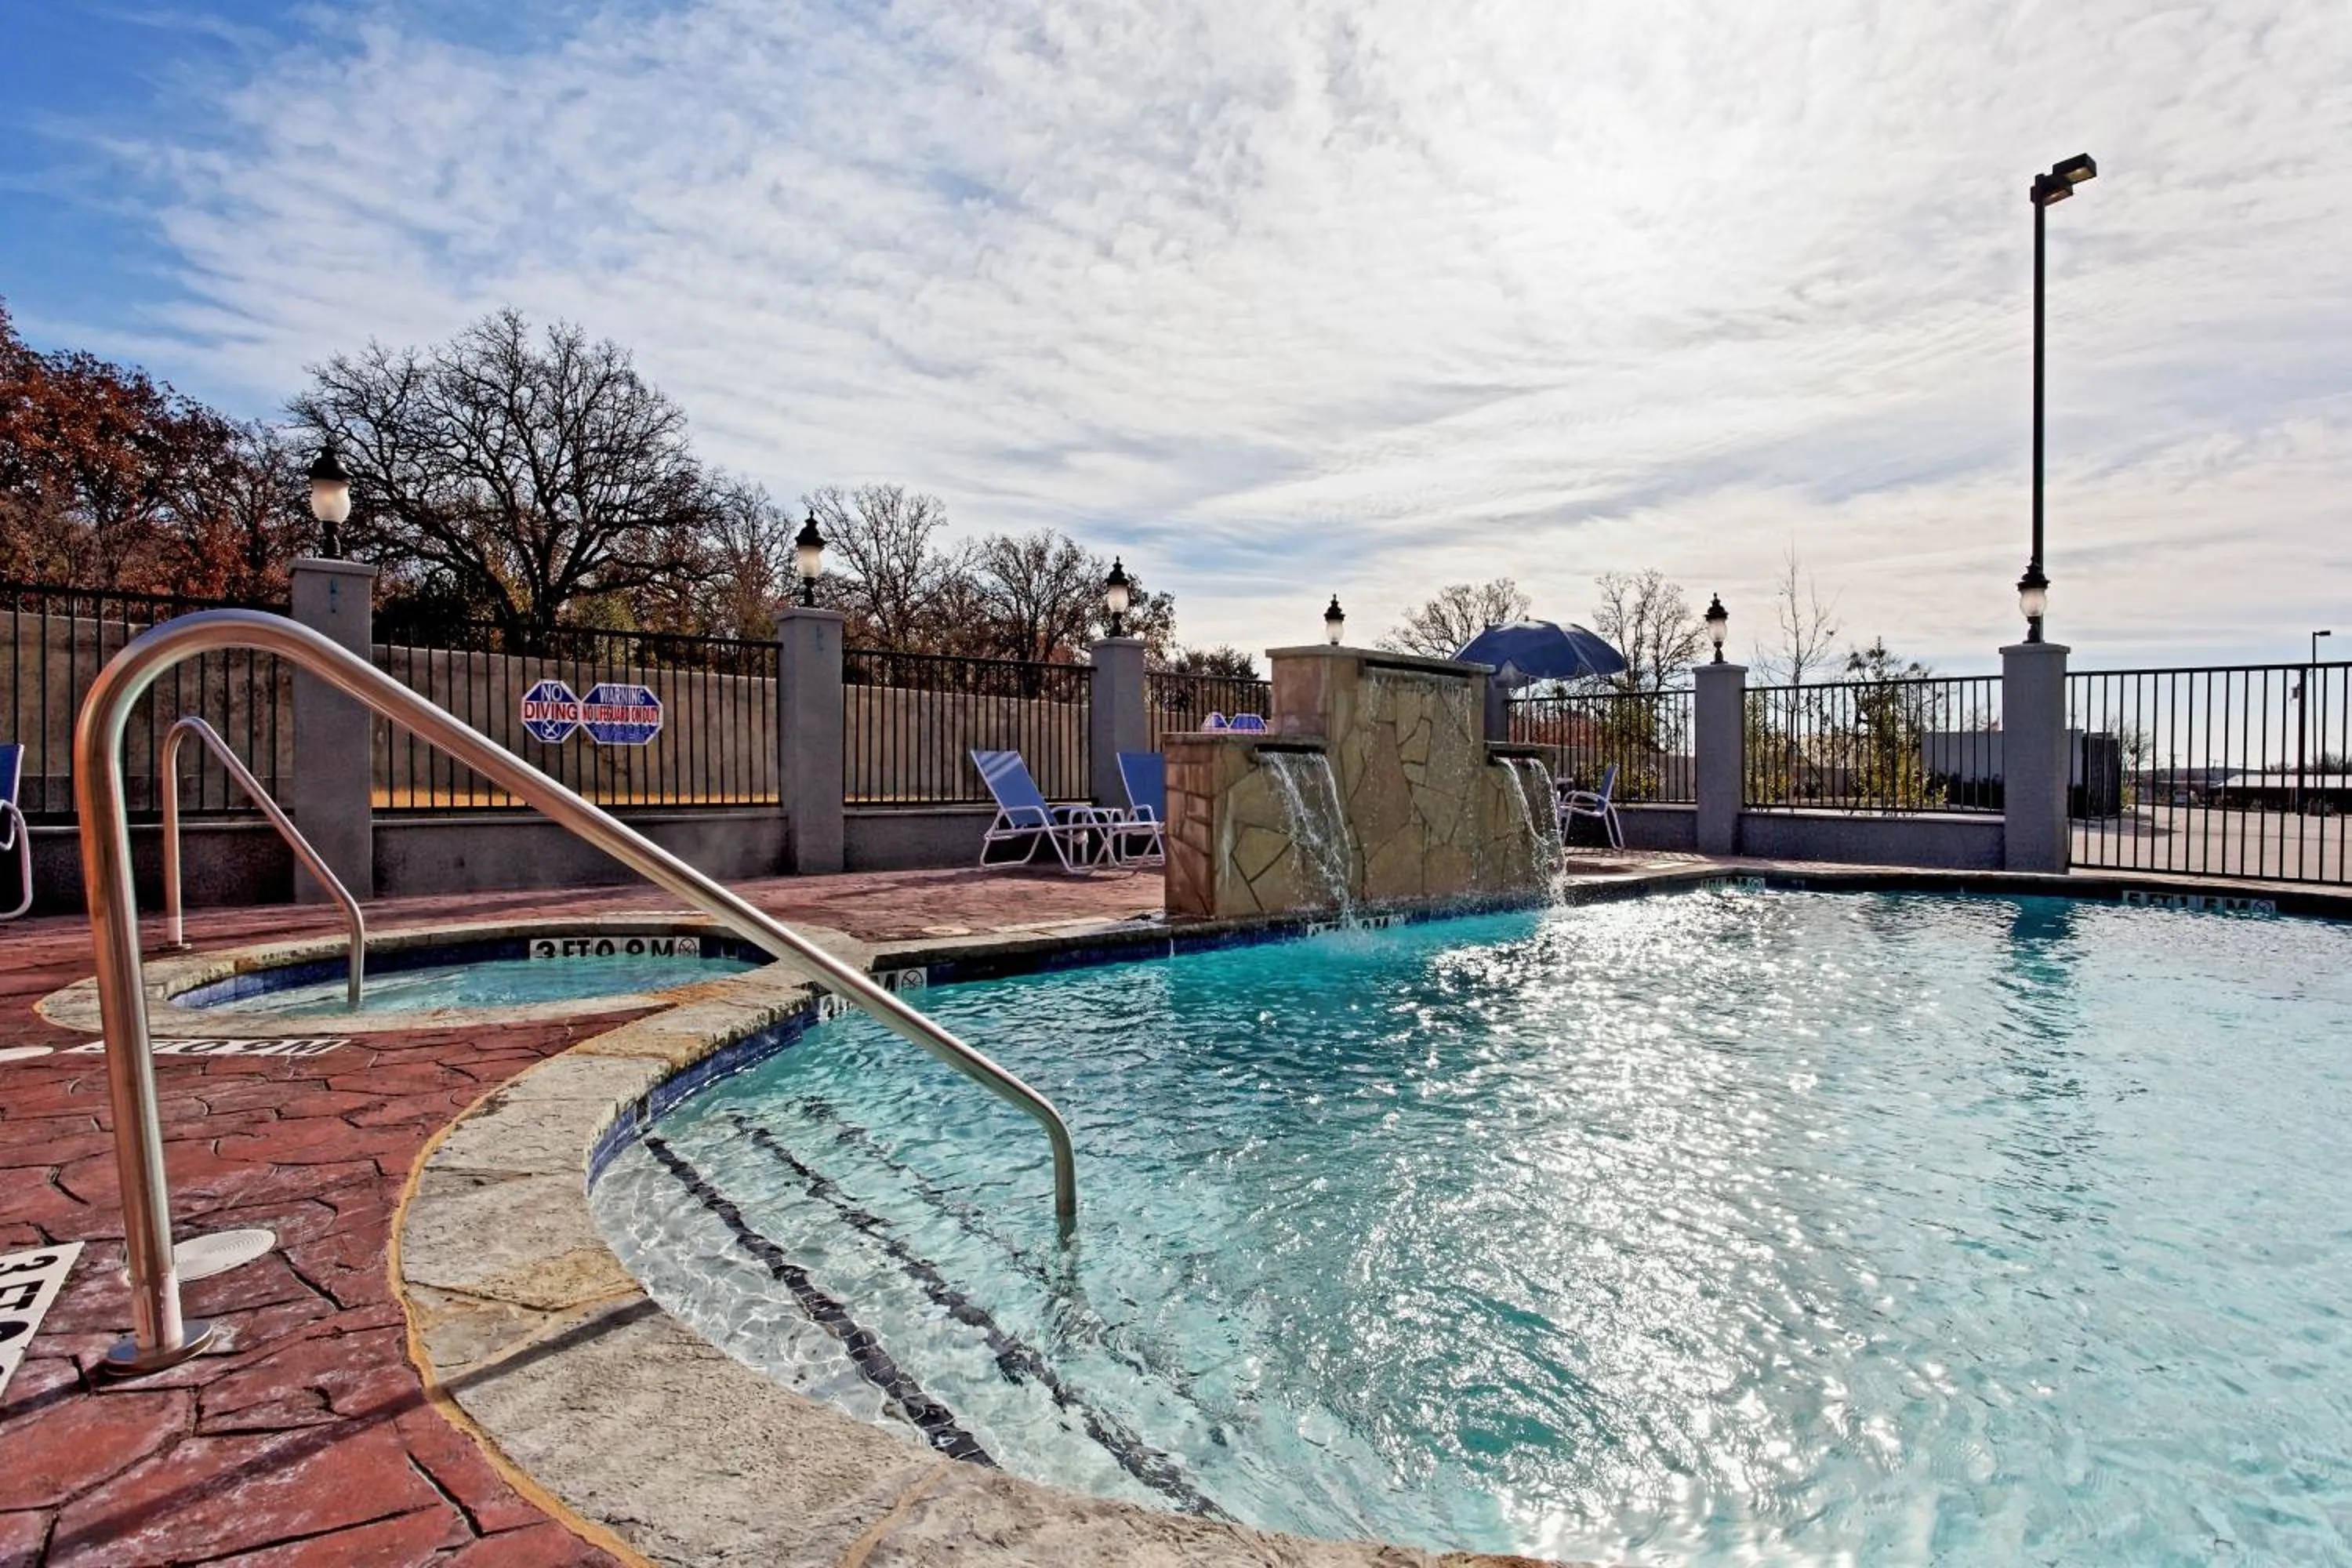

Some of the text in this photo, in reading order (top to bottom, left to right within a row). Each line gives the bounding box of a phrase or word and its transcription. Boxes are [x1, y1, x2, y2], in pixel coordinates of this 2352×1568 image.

[540, 684, 563, 702] NO
[598, 686, 646, 705] WARNING
[524, 702, 579, 720] DIVING
[583, 706, 593, 720] NO
[594, 706, 630, 722] LIFEGUARD
[562, 939, 590, 957] FT
[652, 939, 674, 957] M
[272, 1040, 343, 1054] M
